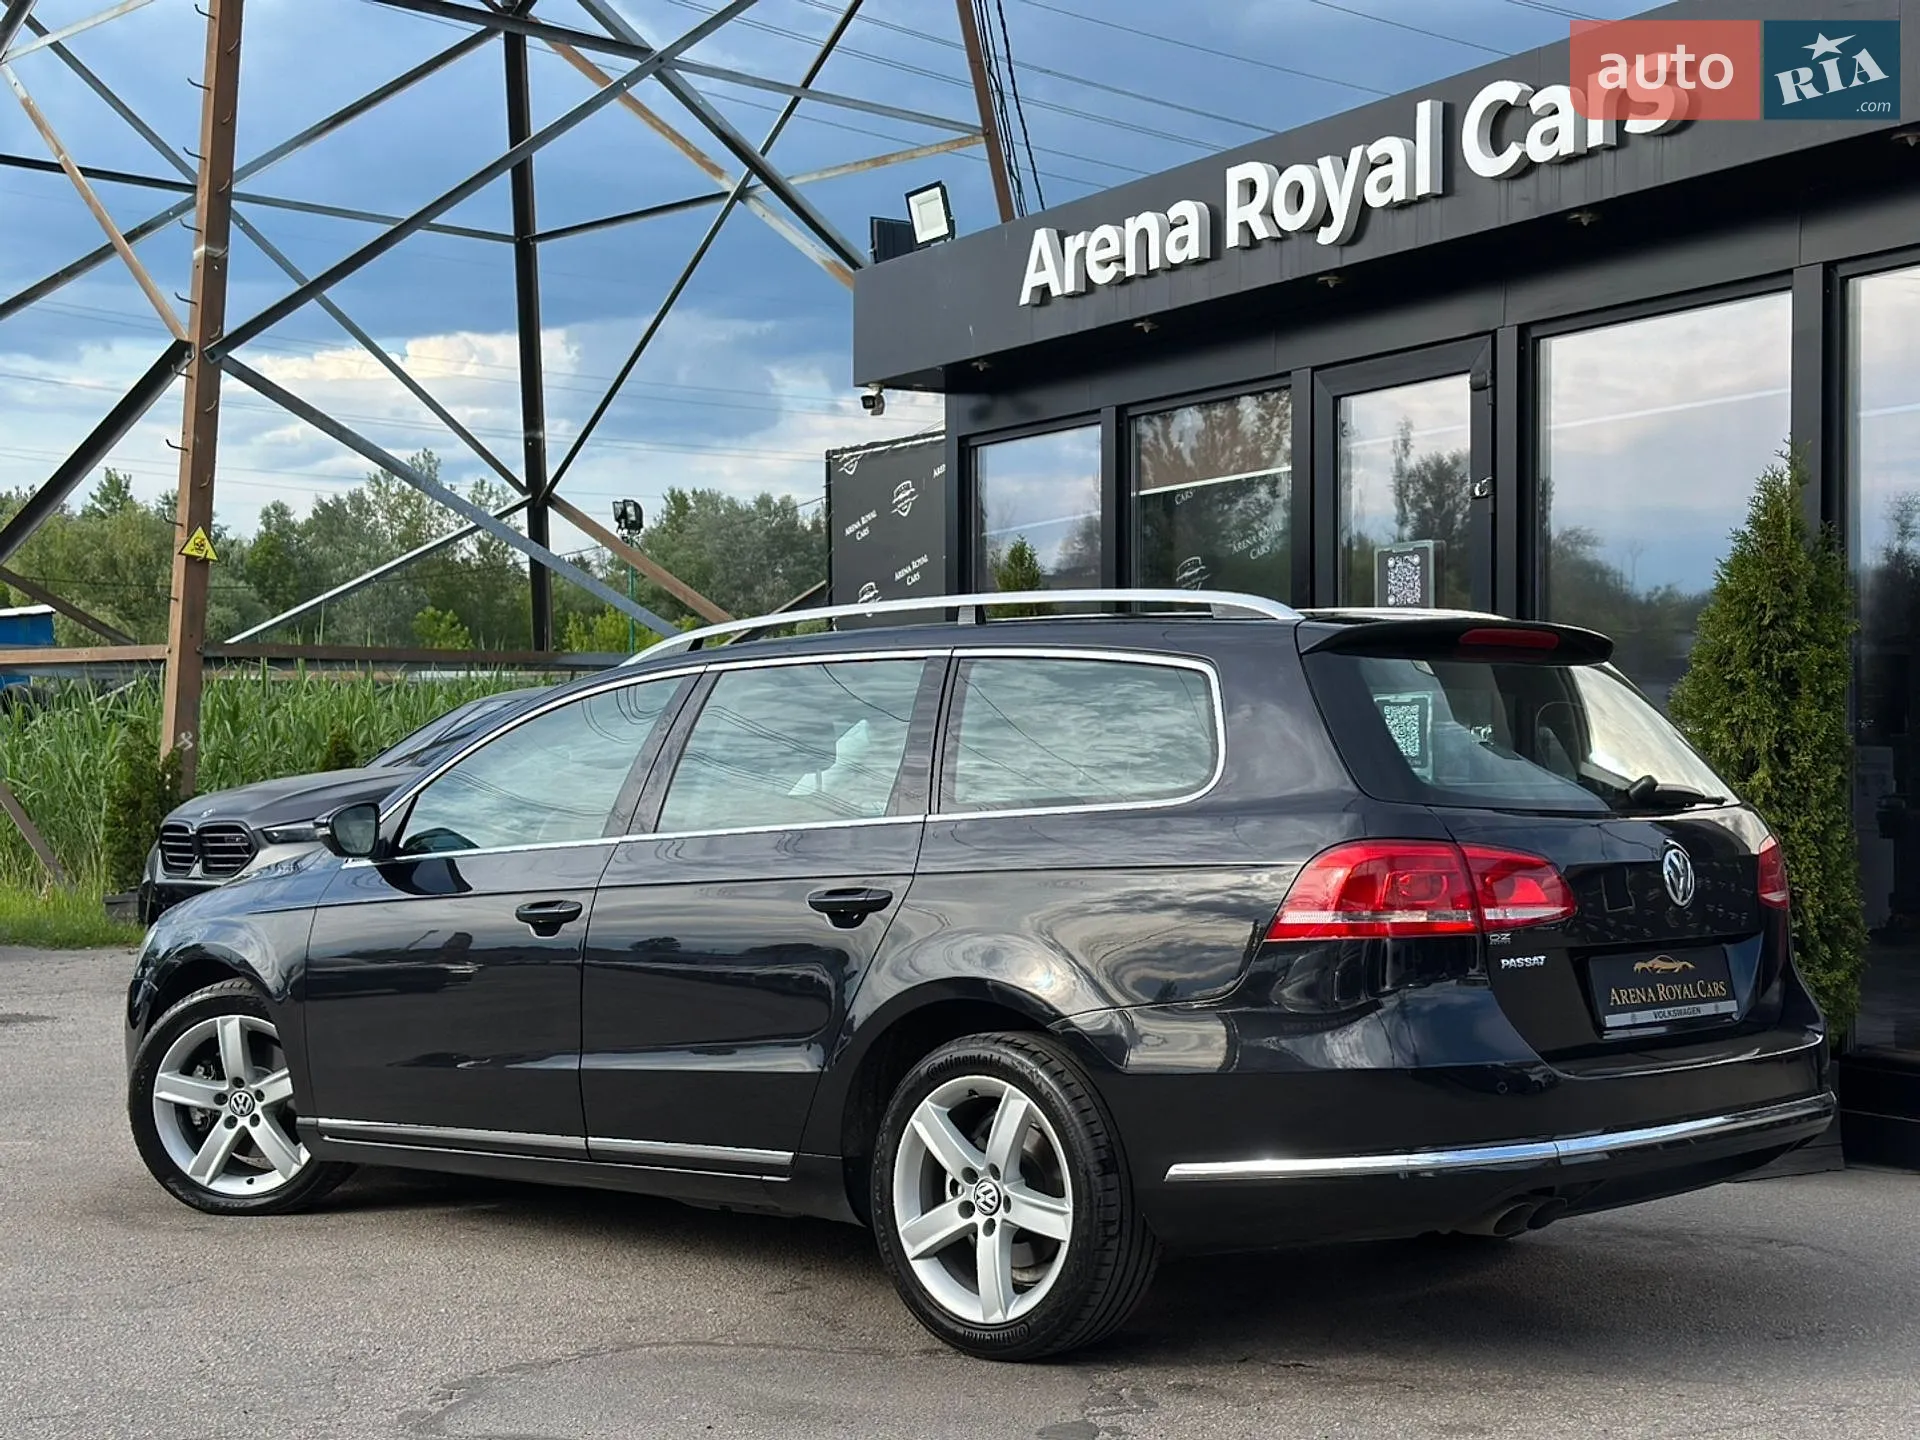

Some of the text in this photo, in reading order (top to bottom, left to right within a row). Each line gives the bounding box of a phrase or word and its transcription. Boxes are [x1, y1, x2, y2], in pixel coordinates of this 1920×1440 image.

[1019, 52, 1684, 305] Arena Royal Cars
[1501, 955, 1546, 969] PASSAT
[1610, 980, 1727, 1006] ARENA ROYAL CARS
[1652, 1006, 1701, 1020] VOLKSWAGEN
